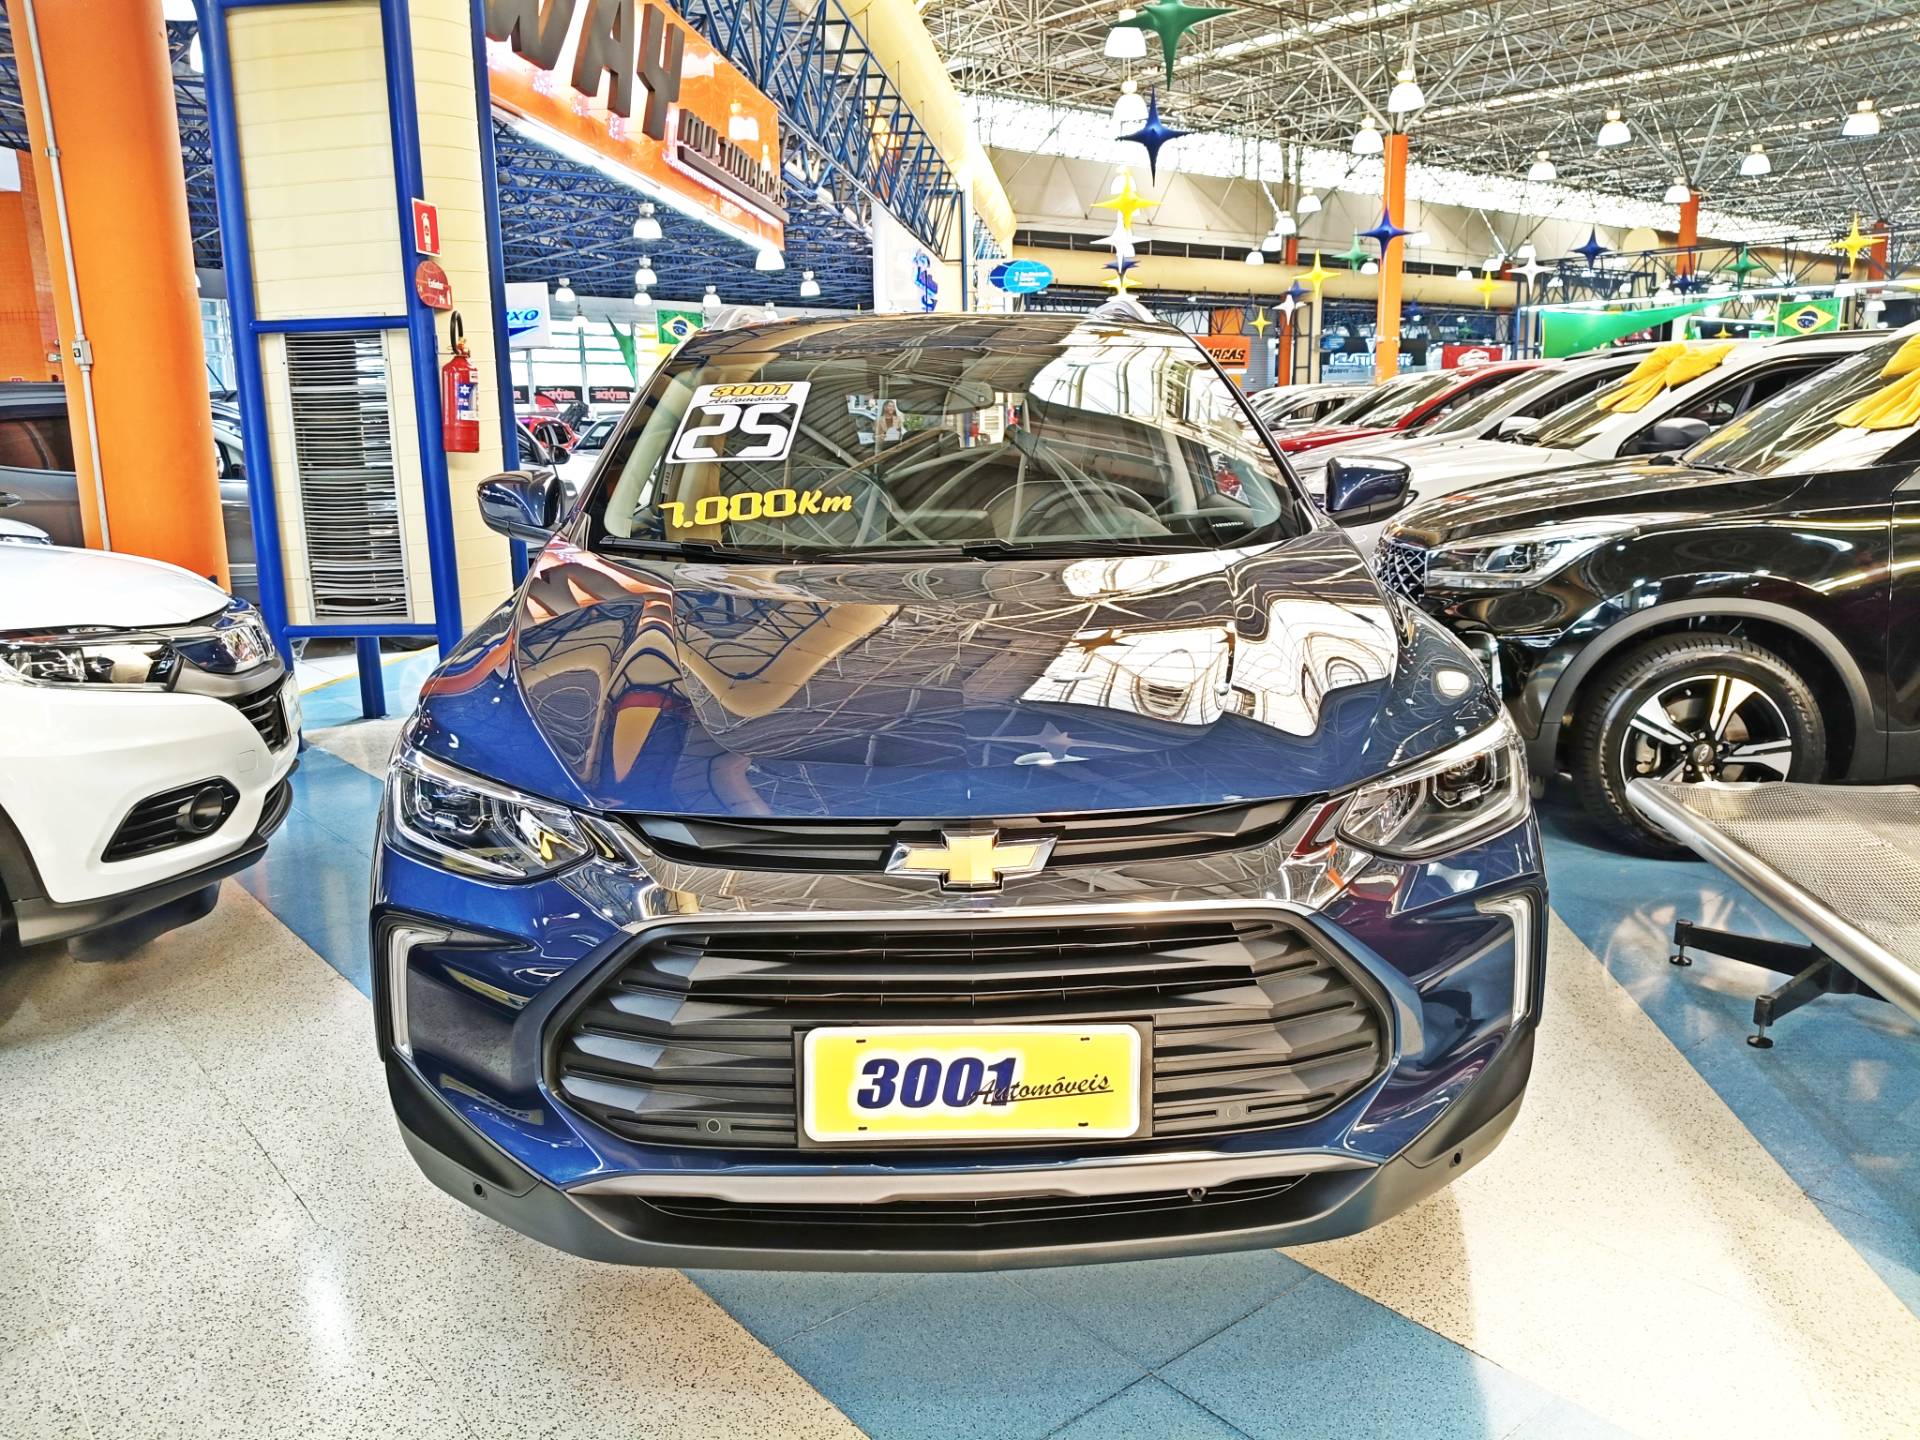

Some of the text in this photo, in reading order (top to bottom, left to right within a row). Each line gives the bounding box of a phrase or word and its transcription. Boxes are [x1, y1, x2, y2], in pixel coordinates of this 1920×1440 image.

[507, 309, 539, 321] XO
[709, 383, 794, 398] 3001
[675, 404, 791, 459] 25
[857, 1057, 1112, 1109] 3001 Automóveis
